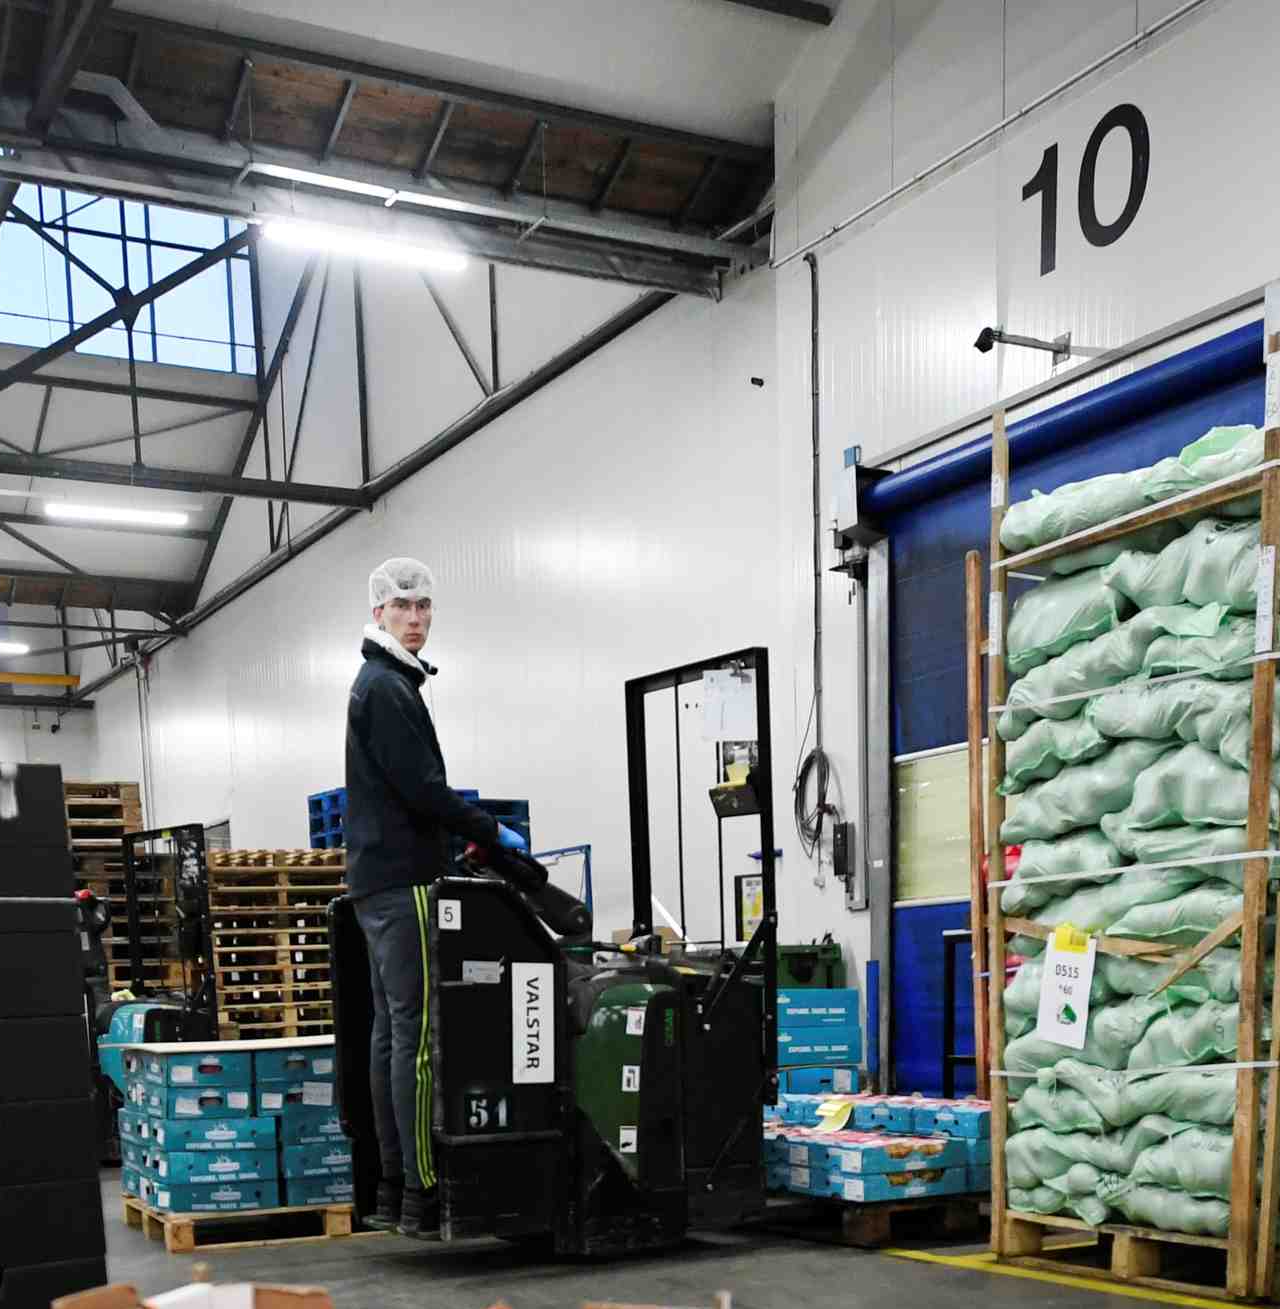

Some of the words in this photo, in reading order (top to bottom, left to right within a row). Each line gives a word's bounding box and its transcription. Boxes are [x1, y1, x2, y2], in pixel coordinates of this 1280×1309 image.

[1022, 103, 1150, 276] 10
[444, 906, 453, 922] 5
[1055, 964, 1080, 979] 0515
[526, 976, 540, 1069] VALSTAR
[469, 1098, 508, 1127] 51
